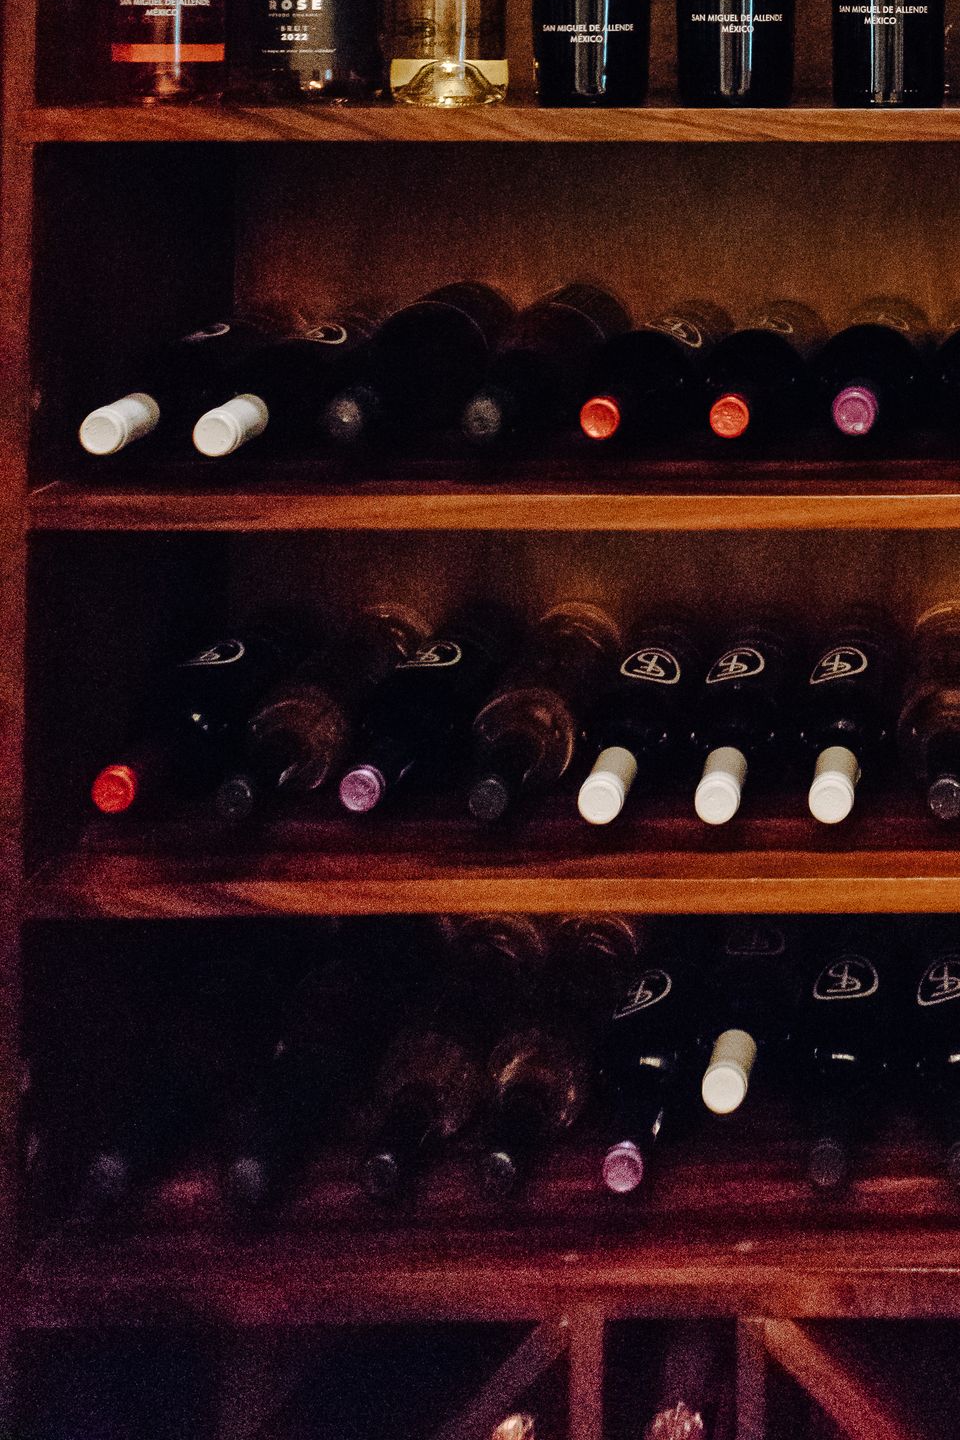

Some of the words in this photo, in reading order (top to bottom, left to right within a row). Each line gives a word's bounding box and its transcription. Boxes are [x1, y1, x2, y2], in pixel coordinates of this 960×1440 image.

[839, 5, 851, 13] SAN
[852, 5, 881, 14] MIGUEL
[895, 6, 928, 14] ALLENDE
[692, 14, 706, 22] SAN
[708, 14, 738, 22] MIGUEL
[753, 14, 783, 22] ALLENDE
[863, 15, 897, 25] MÉXICO
[602, 24, 634, 32] ALLENDE
[721, 23, 754, 33] MÉXICO
[281, 33, 308, 41] 2022
[570, 33, 603, 43] MÉXICO
